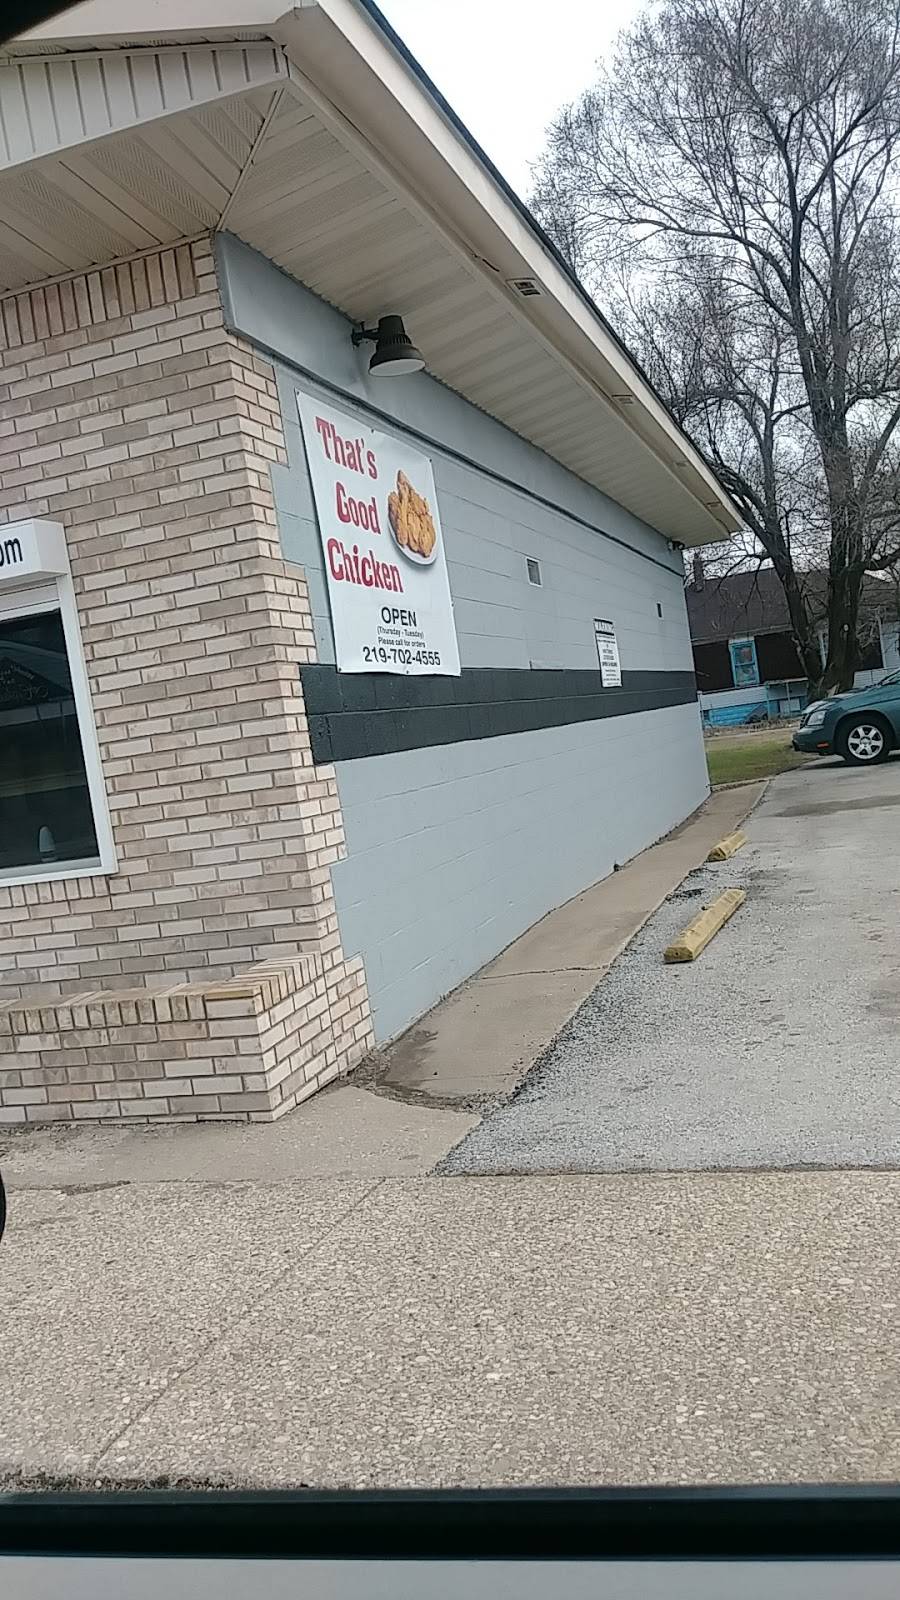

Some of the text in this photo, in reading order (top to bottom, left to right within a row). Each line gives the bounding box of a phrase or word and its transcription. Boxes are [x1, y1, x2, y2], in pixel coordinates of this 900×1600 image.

[315, 416, 377, 479] That's
[336, 481, 381, 534] Good
[327, 538, 404, 593] Chicken
[381, 607, 417, 627] OPEN
[362, 646, 441, 666] 219-702-4555
